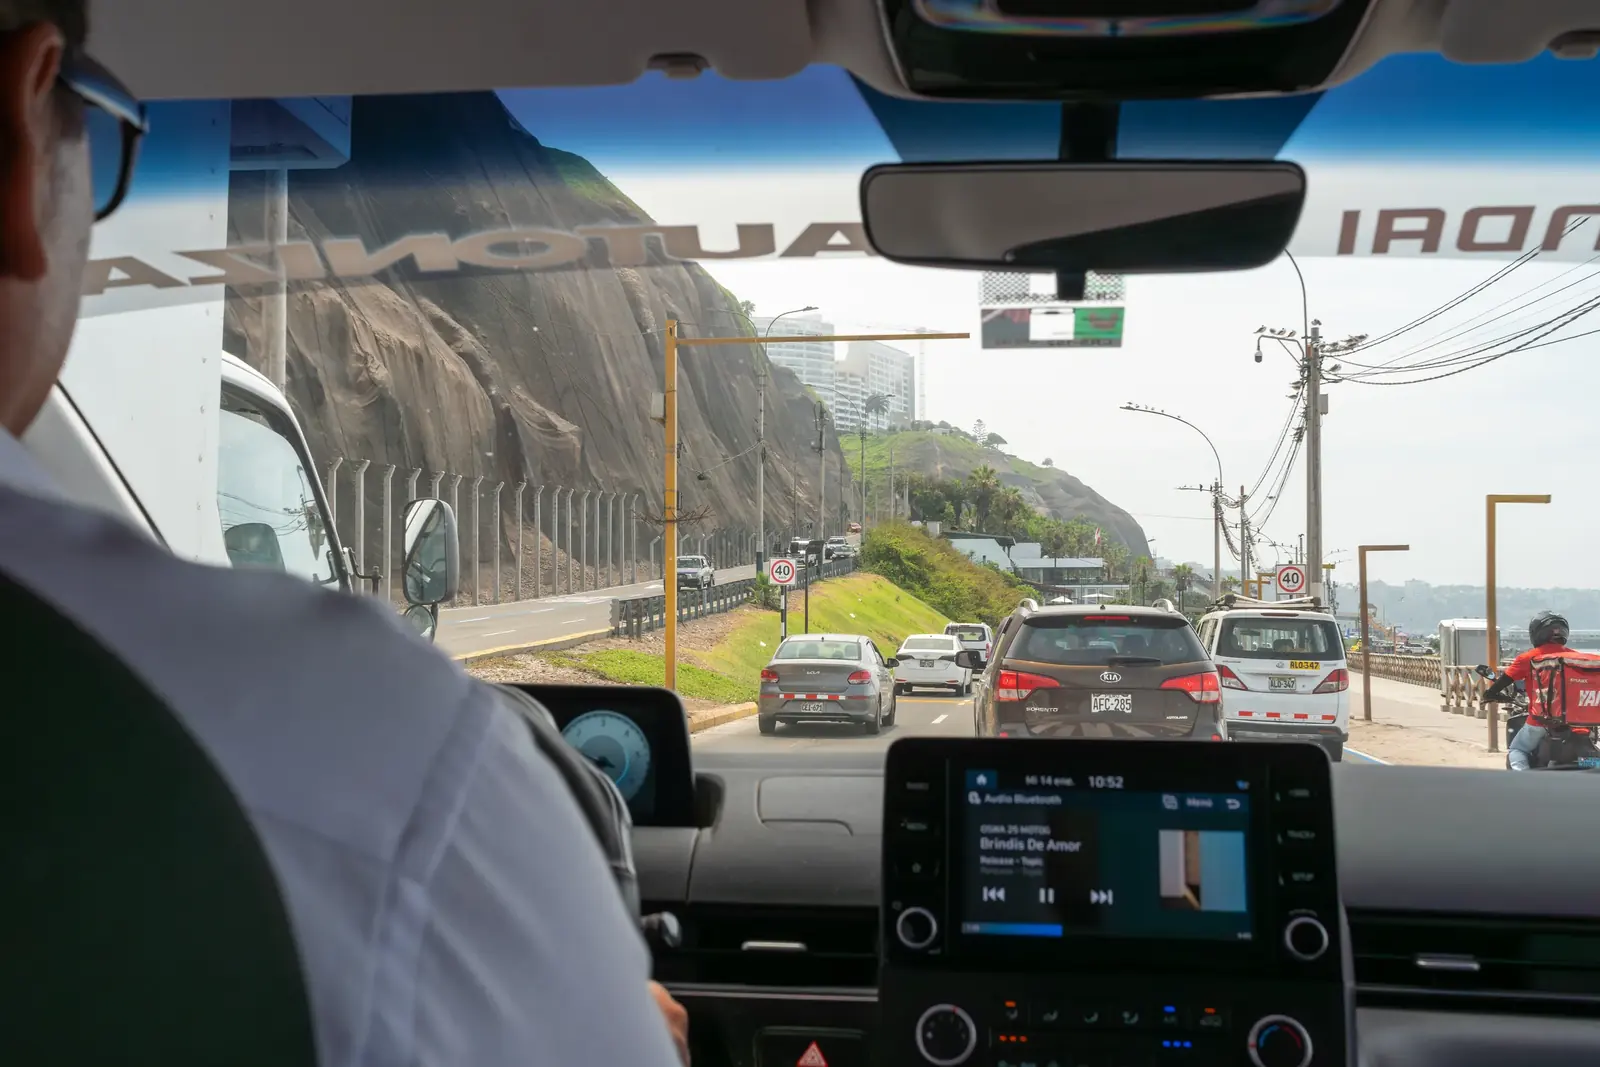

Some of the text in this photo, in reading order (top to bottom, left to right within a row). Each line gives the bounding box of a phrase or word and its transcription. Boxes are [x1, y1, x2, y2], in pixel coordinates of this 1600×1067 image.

[775, 565, 790, 576] 40
[1282, 572, 1299, 584] 40
[1103, 673, 1119, 682] KIA
[1093, 697, 1132, 711] AFC-285
[1038, 776, 1052, 786] 14
[1088, 776, 1124, 789] 10:52
[983, 794, 1062, 805] Audio Bluetooth
[980, 837, 1082, 852] Brindis De Amor
[980, 855, 1014, 866] Release
